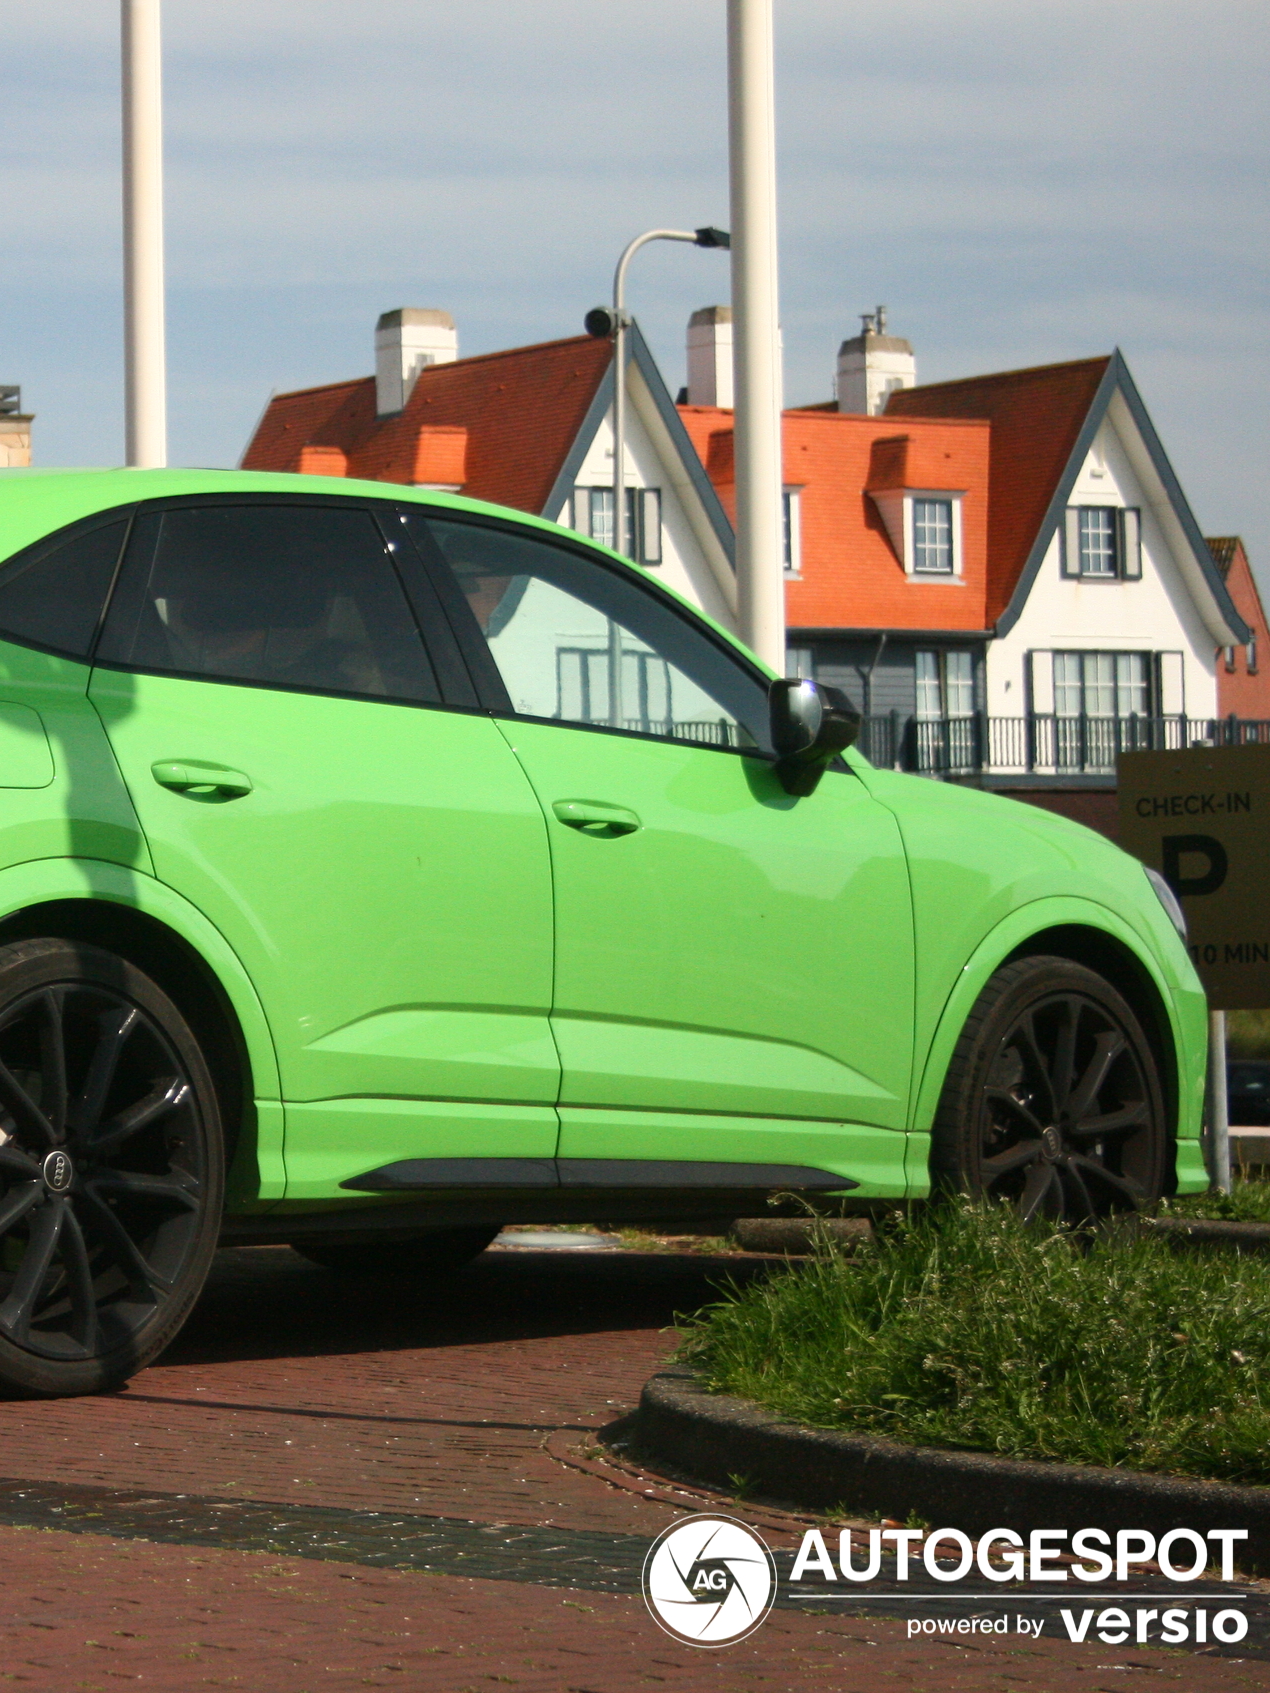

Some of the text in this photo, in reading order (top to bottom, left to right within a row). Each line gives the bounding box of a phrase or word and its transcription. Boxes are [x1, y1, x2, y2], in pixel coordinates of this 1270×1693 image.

[1135, 792, 1251, 818] CHECK-IN
[1161, 833, 1228, 896] P
[1189, 942, 1269, 965] 10 MIN
